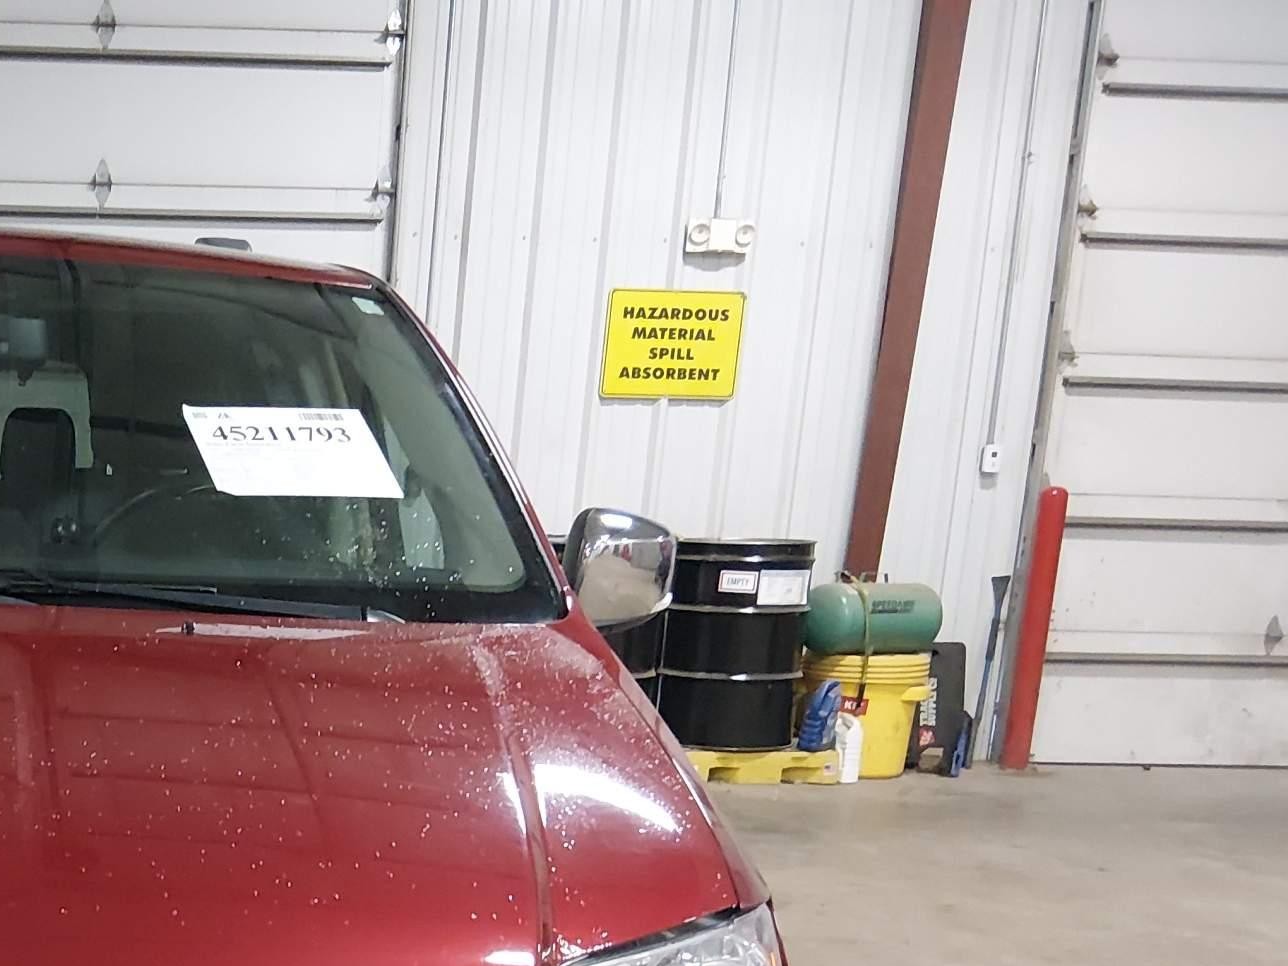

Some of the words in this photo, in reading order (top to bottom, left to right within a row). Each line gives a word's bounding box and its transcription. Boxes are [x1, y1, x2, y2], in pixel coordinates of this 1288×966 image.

[623, 306, 730, 321] HAZARDOUS
[632, 326, 716, 341] MATERIAL
[648, 347, 694, 360] SPILL
[619, 366, 720, 381] ABSORBENT
[212, 425, 352, 443] 45211793
